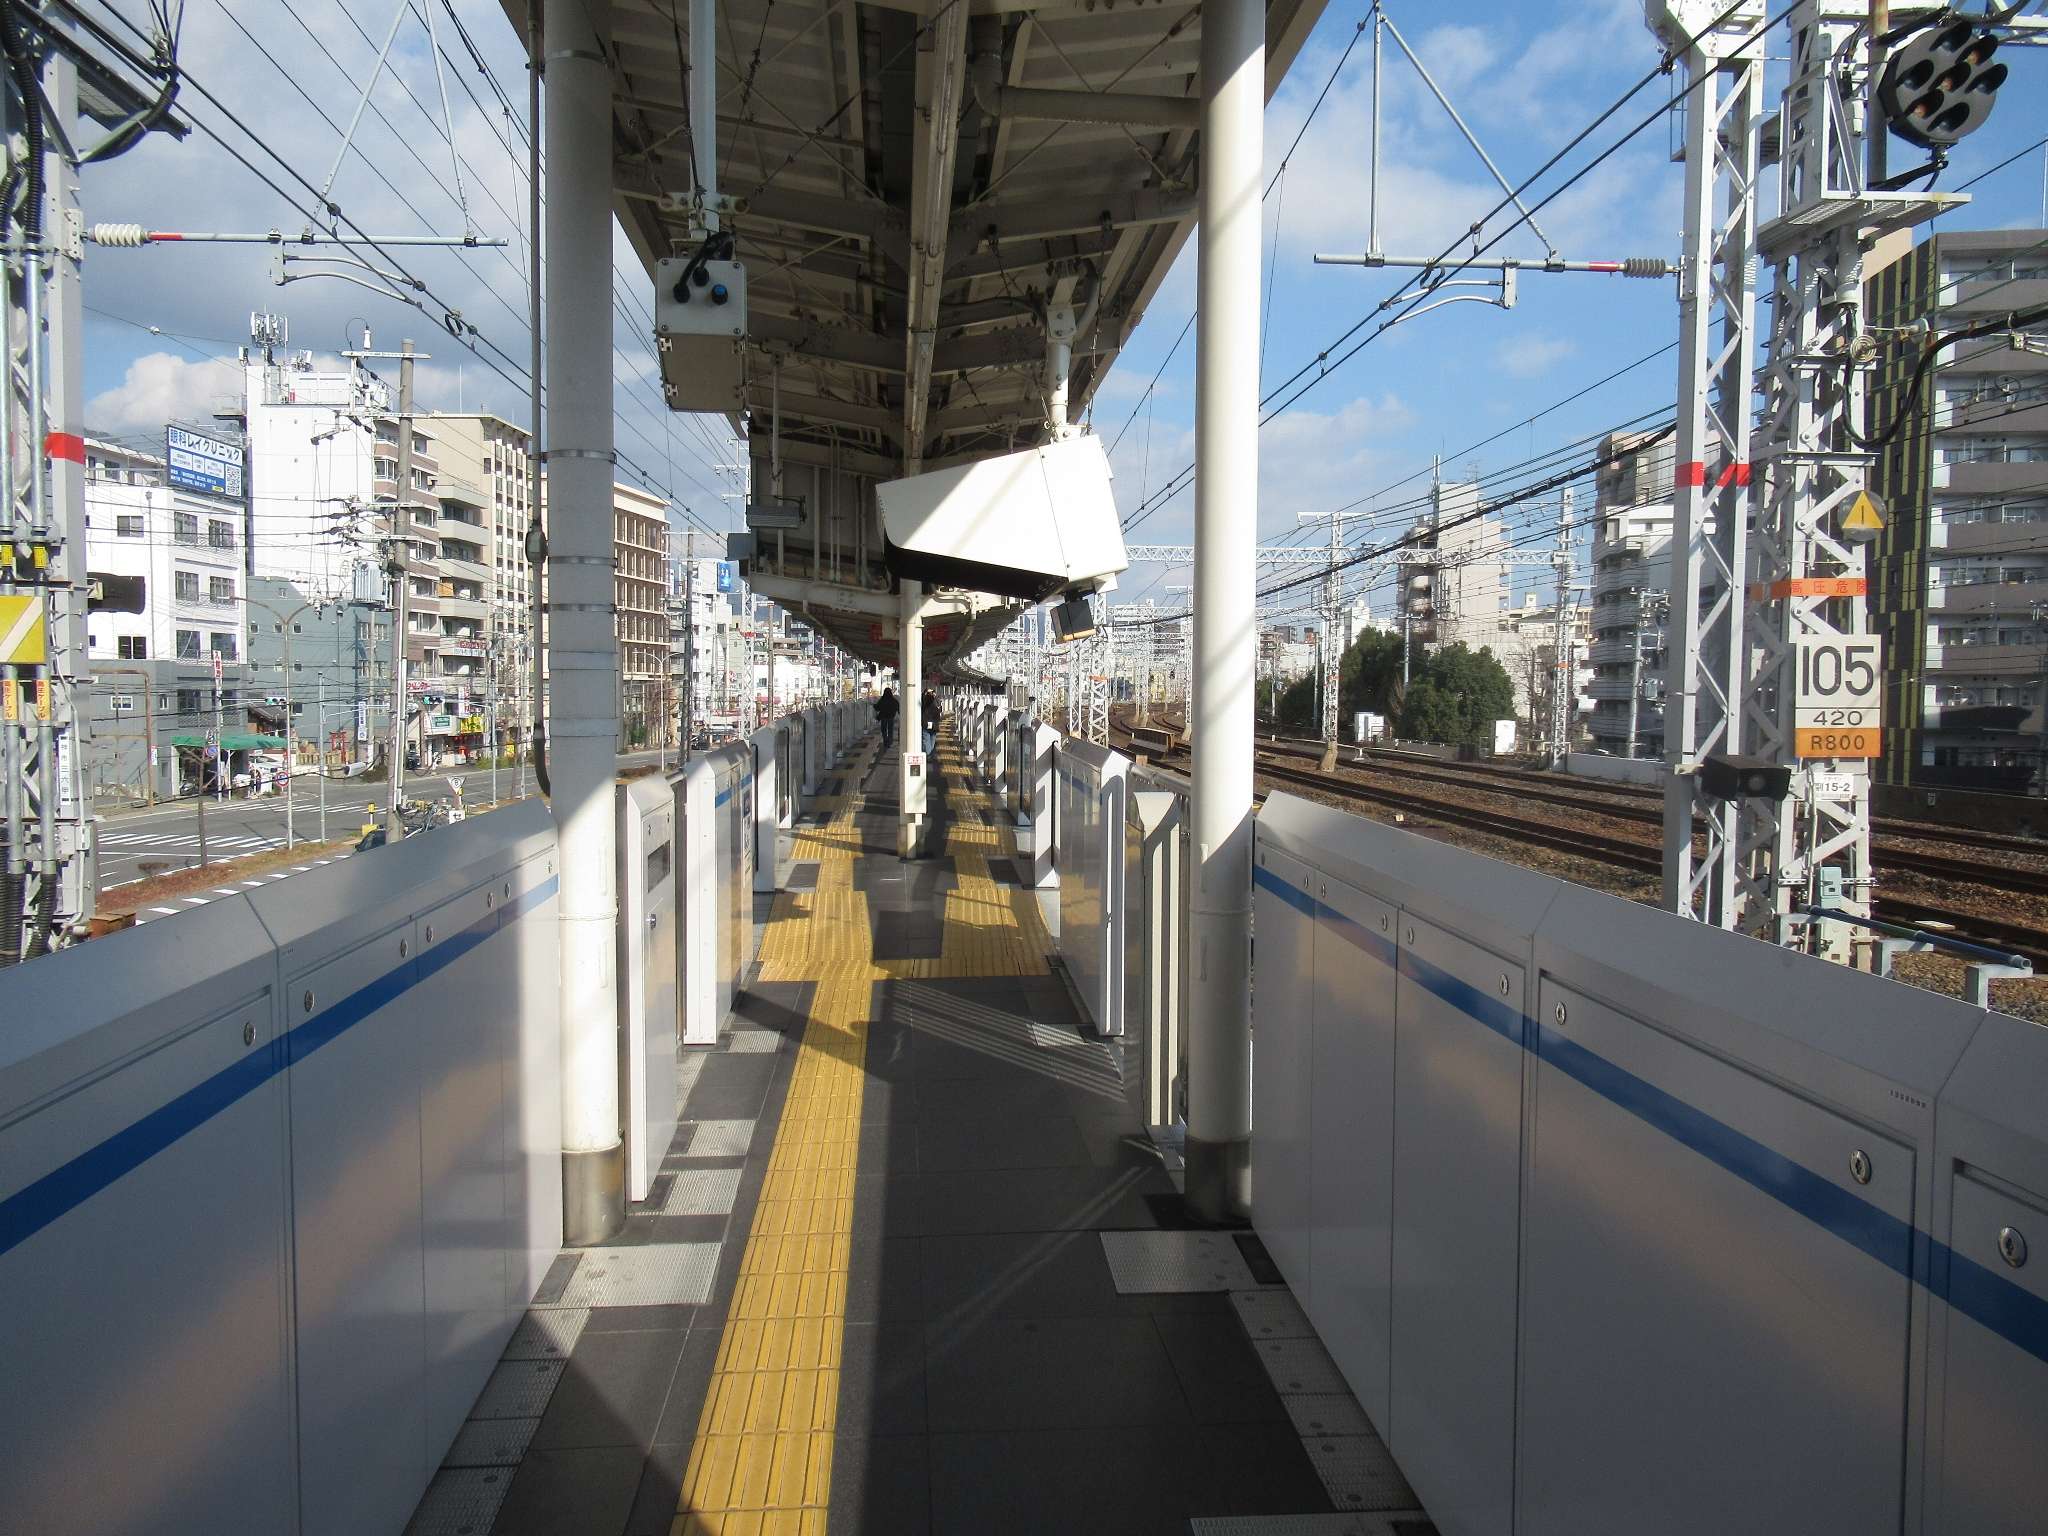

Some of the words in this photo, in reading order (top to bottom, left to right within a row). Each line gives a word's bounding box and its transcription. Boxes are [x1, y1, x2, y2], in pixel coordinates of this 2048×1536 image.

[170, 428, 240, 461] 眼科レイクリニック
[1802, 645, 1874, 696] 105
[1813, 710, 1863, 726] 420
[1811, 734, 1865, 751] R800
